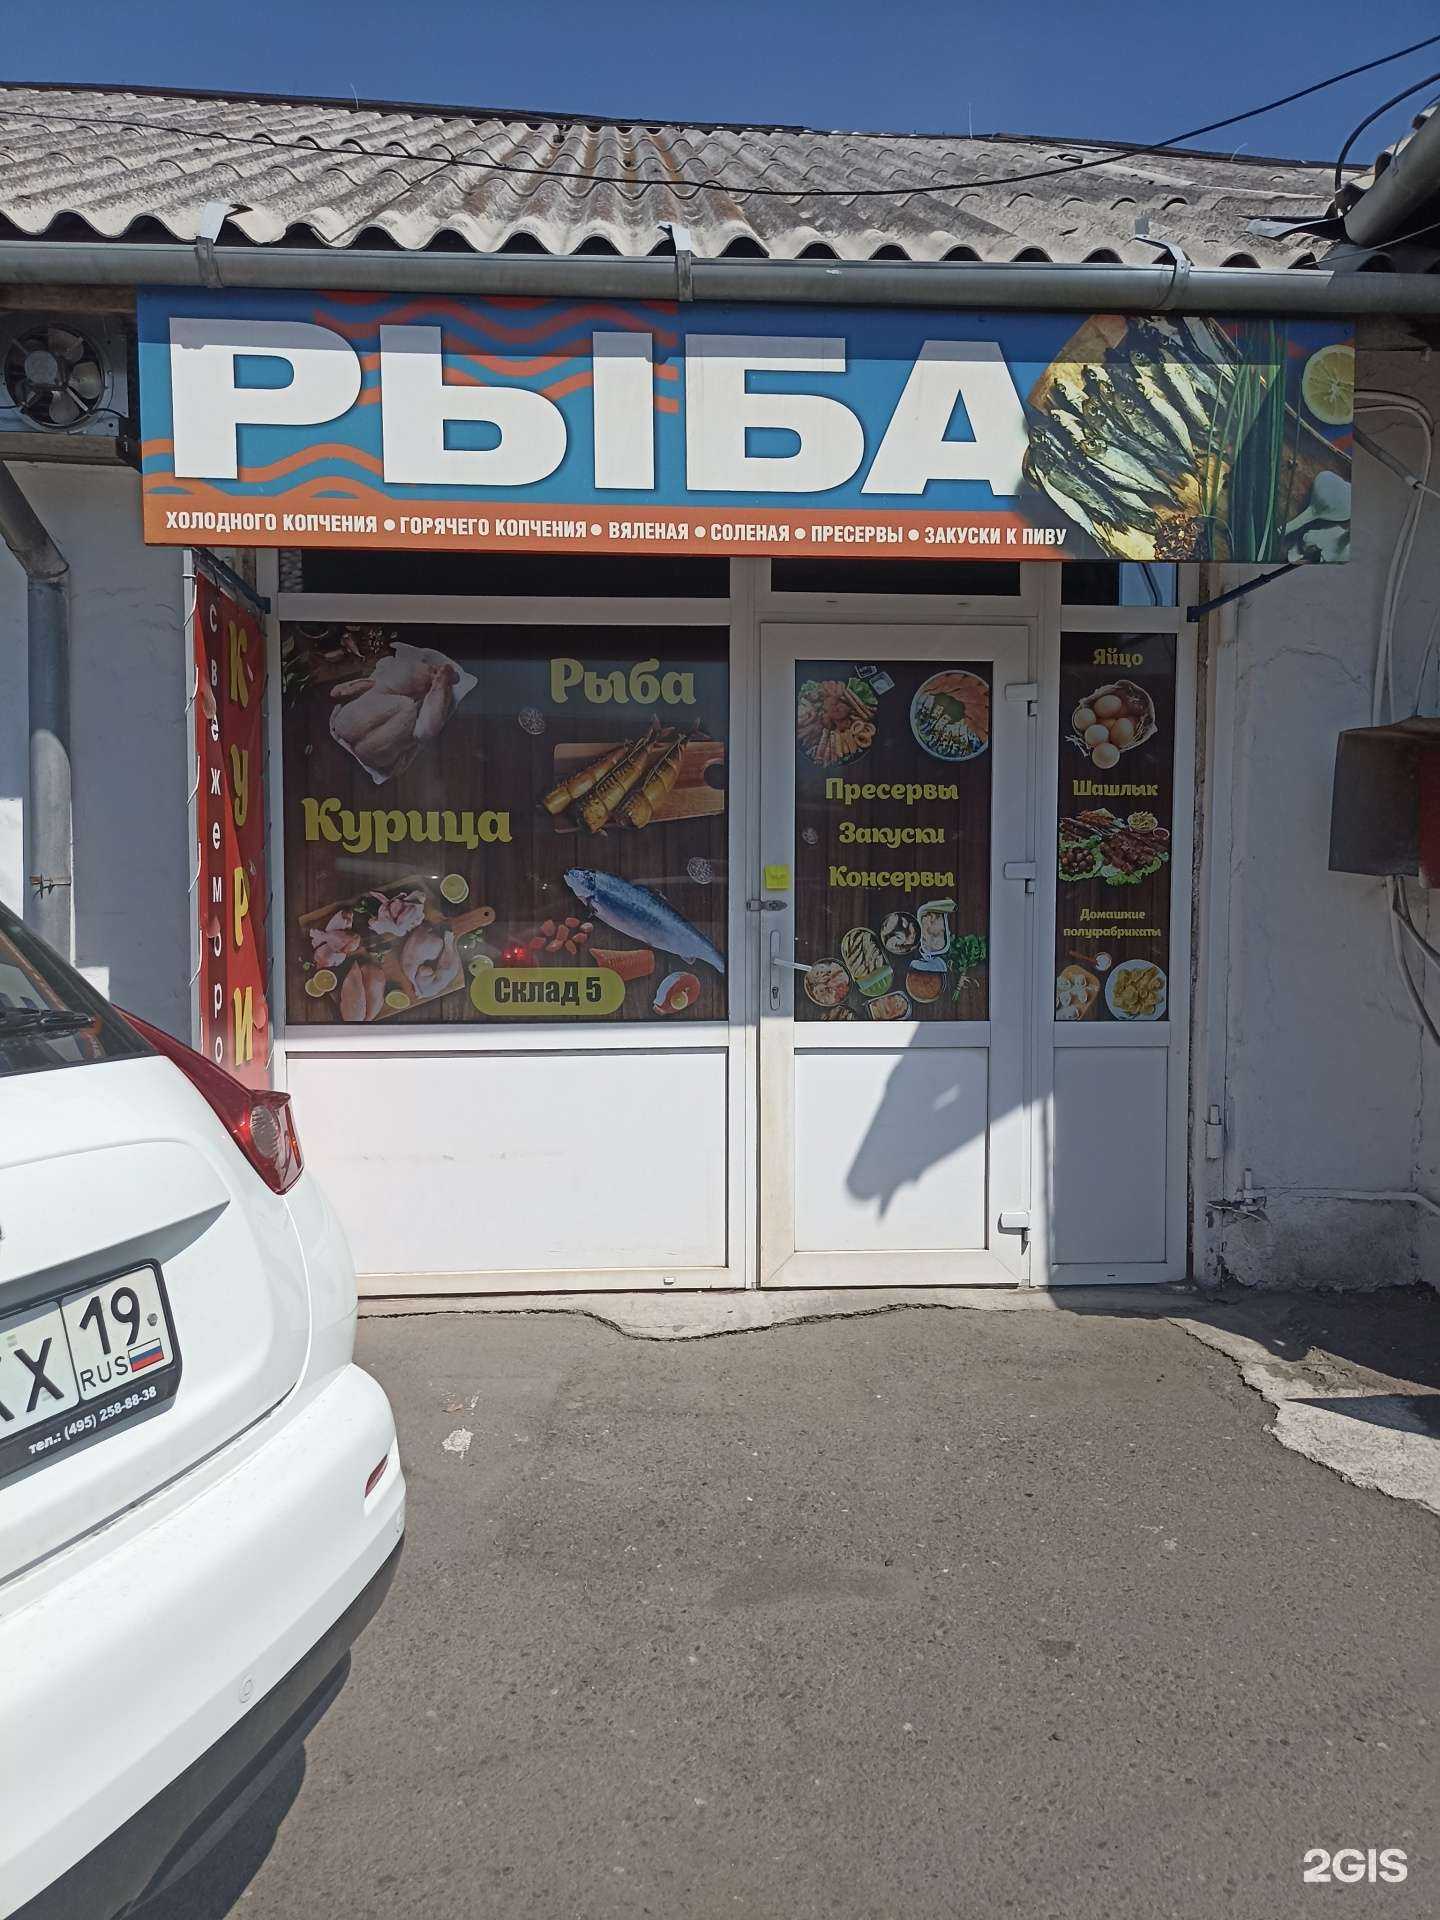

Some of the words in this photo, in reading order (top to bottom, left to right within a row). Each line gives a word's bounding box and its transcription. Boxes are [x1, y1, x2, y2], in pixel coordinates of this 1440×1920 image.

[169, 317, 1023, 496] РЫБА
[165, 511, 277, 534] ХОЛОДНОГО
[282, 513, 378, 534] КОПЧЕНИЯ
[400, 516, 490, 537] ГОРЯЧЕГО
[496, 519, 587, 539] КОПЧЕНИЯ
[608, 522, 689, 541] ВЯЛЕНАЯ
[710, 523, 790, 543] СОЛЕНАЯ
[811, 525, 903, 544] ПРЕСЕРВЫ
[924, 526, 1001, 545] ЗАКУСКИ
[1006, 527, 1018, 545] К
[1022, 527, 1067, 546] ПИВУ
[1092, 648, 1144, 667] Яйцо
[550, 657, 697, 705] Рыба
[825, 777, 959, 805] Пресервы
[1072, 780, 1159, 797] Шашлык
[302, 797, 513, 854] Курица
[838, 821, 945, 849] Закуски
[828, 865, 955, 892] Консервы
[1080, 908, 1146, 921] Домашние
[1063, 926, 1162, 938] полуфабрикаты
[494, 975, 582, 1007] Склад
[585, 976, 602, 1003] 5
[79, 1286, 141, 1355] 19
[80, 1355, 129, 1392] RUS
[28, 1431, 62, 1454] тел.:
[64, 1413, 97, 1440] (495)
[99, 1386, 157, 1422] 258-88-38
